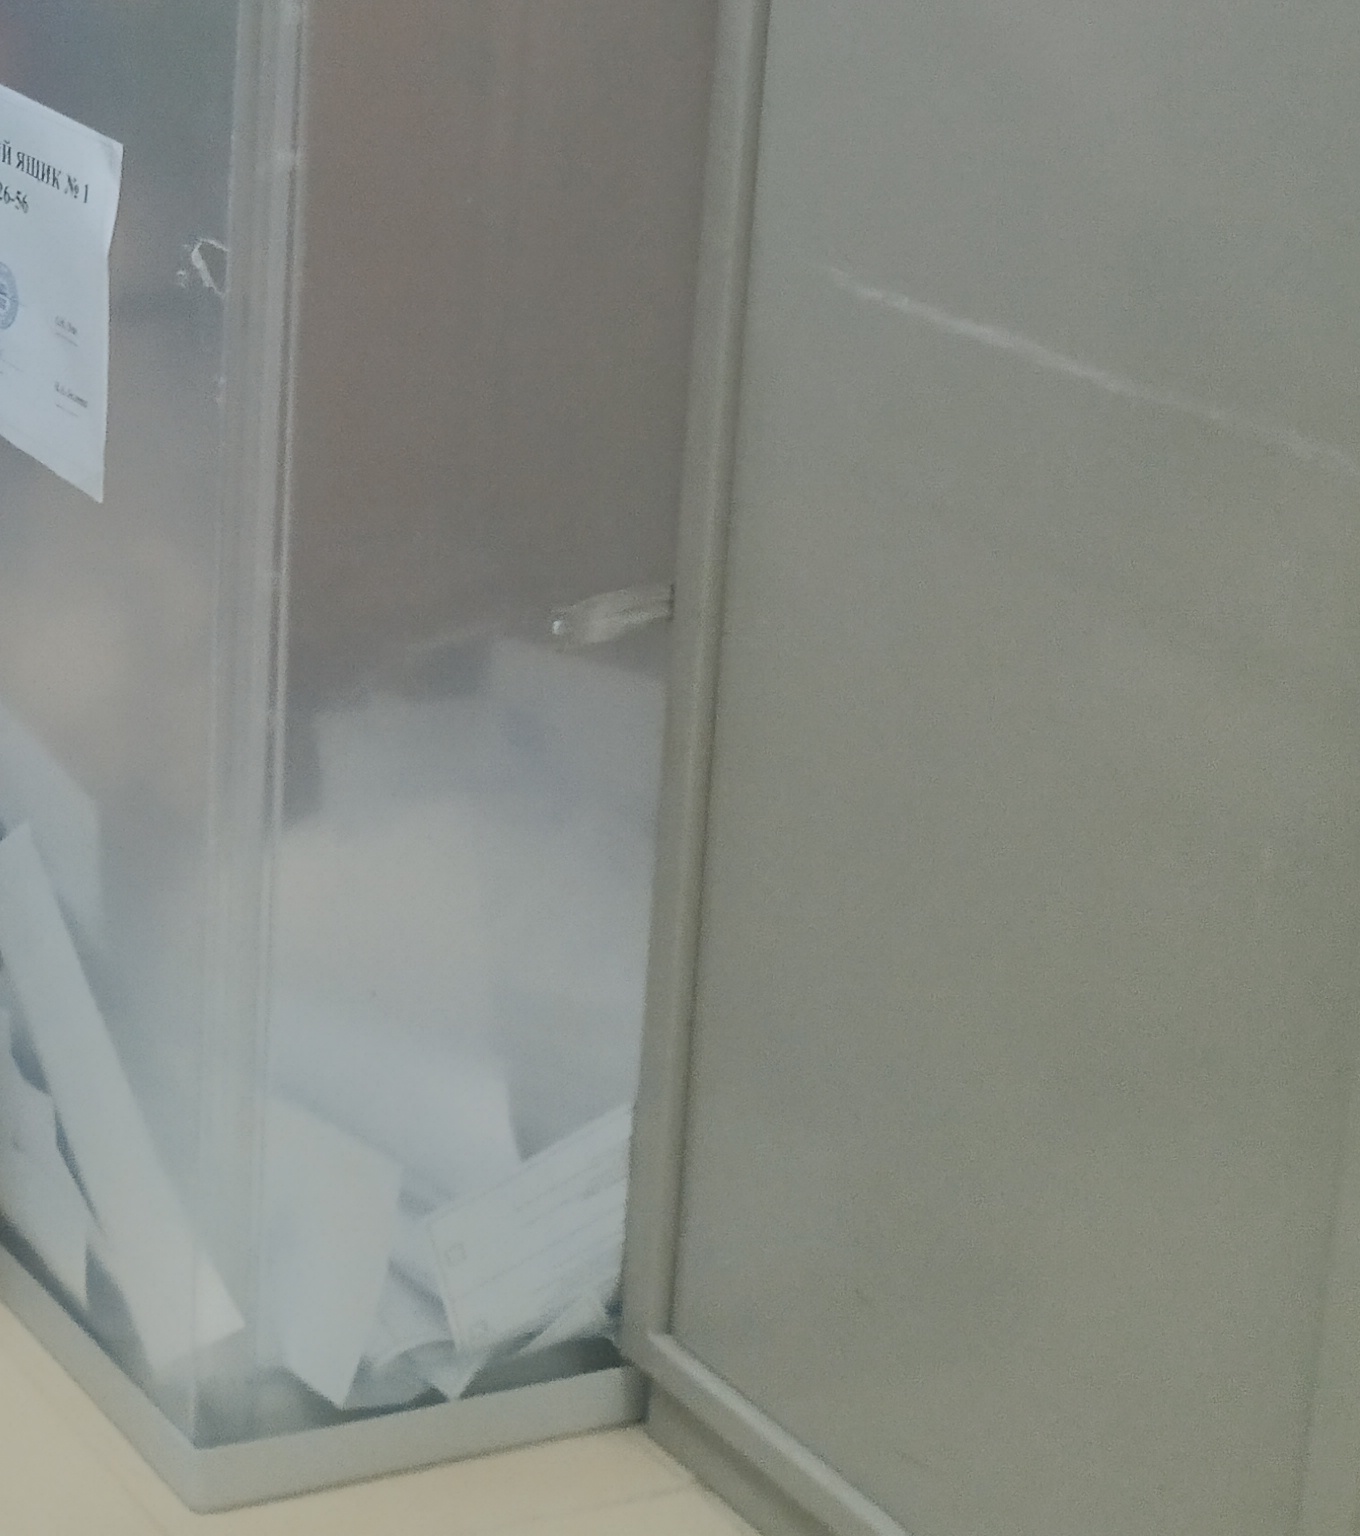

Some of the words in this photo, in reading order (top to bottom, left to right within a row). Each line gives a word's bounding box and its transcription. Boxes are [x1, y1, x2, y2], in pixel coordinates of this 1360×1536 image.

[15, 151, 62, 190] ЯЩИК
[63, 173, 80, 199] №
[82, 183, 89, 204] 1
